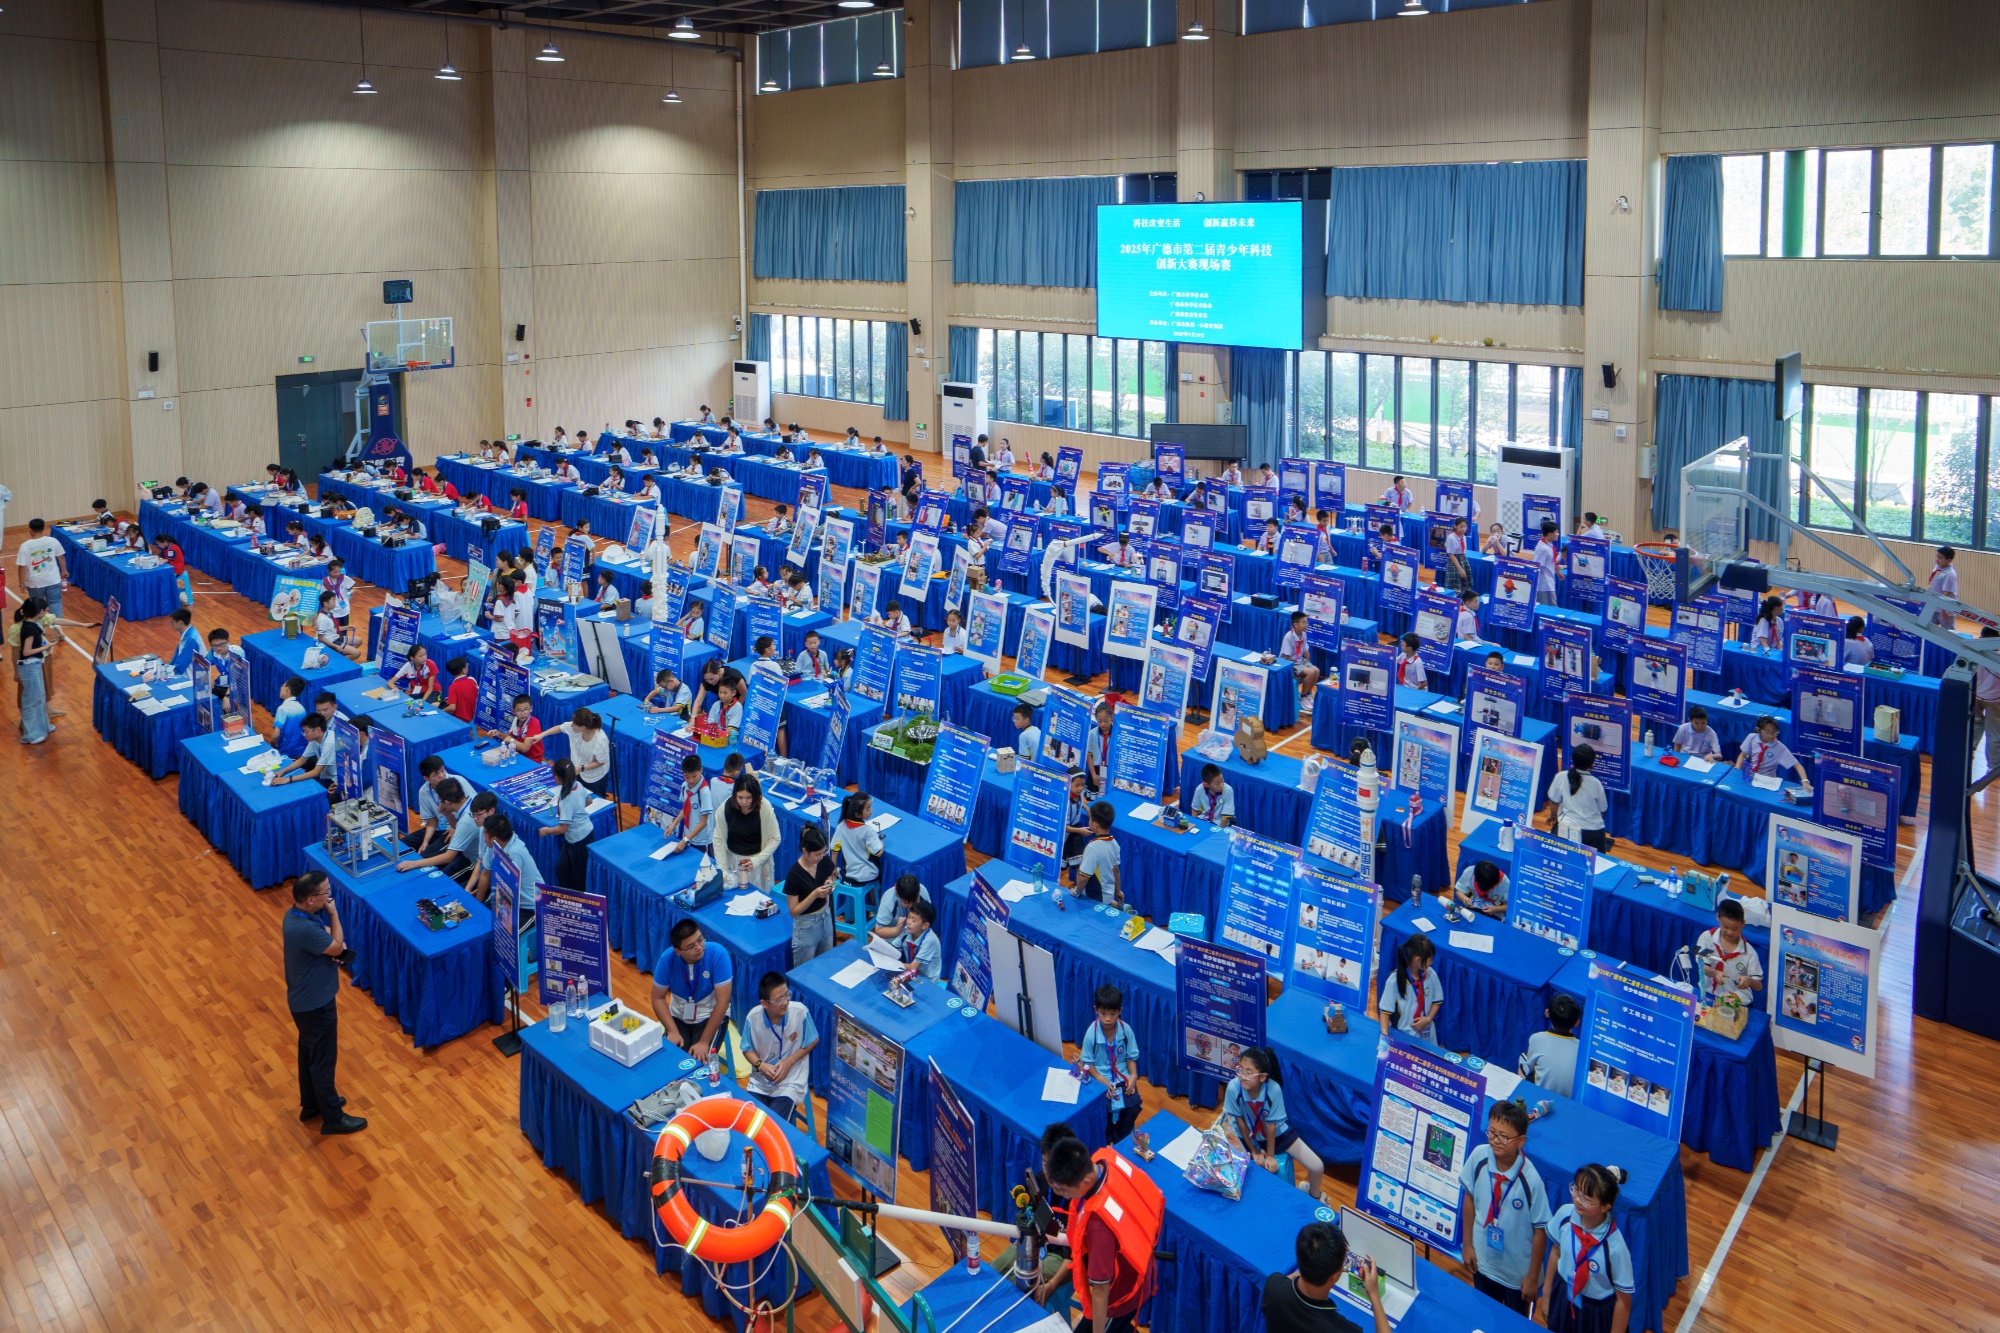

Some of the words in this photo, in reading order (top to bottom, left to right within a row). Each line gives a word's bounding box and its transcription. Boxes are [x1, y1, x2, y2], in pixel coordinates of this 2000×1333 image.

[1133, 218, 1181, 228] 科技改变生活
[1203, 217, 1255, 228] 创新赢得未来
[1120, 242, 1273, 257] 2025年广德市第二届青少年科技
[1156, 257, 1231, 271] 创新大赛现场赛
[1469, 1054, 1483, 1063] 34
